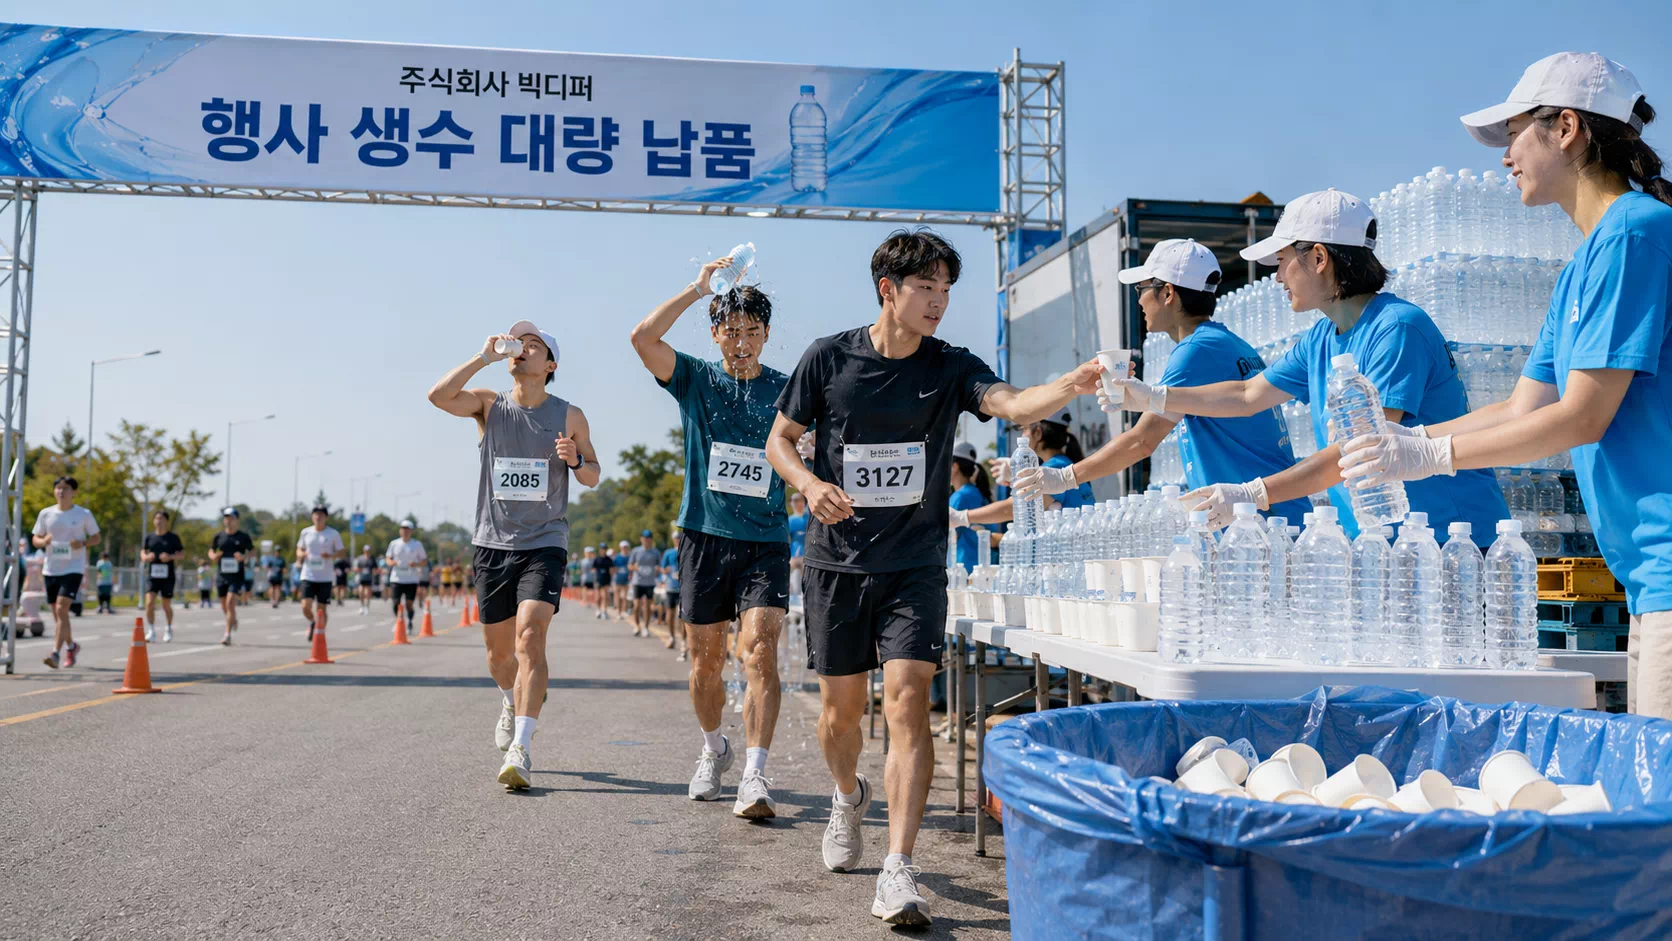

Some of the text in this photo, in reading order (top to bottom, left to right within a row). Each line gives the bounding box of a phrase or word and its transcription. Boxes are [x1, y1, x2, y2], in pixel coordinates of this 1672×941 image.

[399, 66, 593, 102] 주식회사 빅디퍼
[200, 97, 757, 180] 행사 생수 대량 납품
[500, 472, 540, 488] 2085
[717, 460, 763, 482] 2745
[855, 465, 914, 488] 3127
